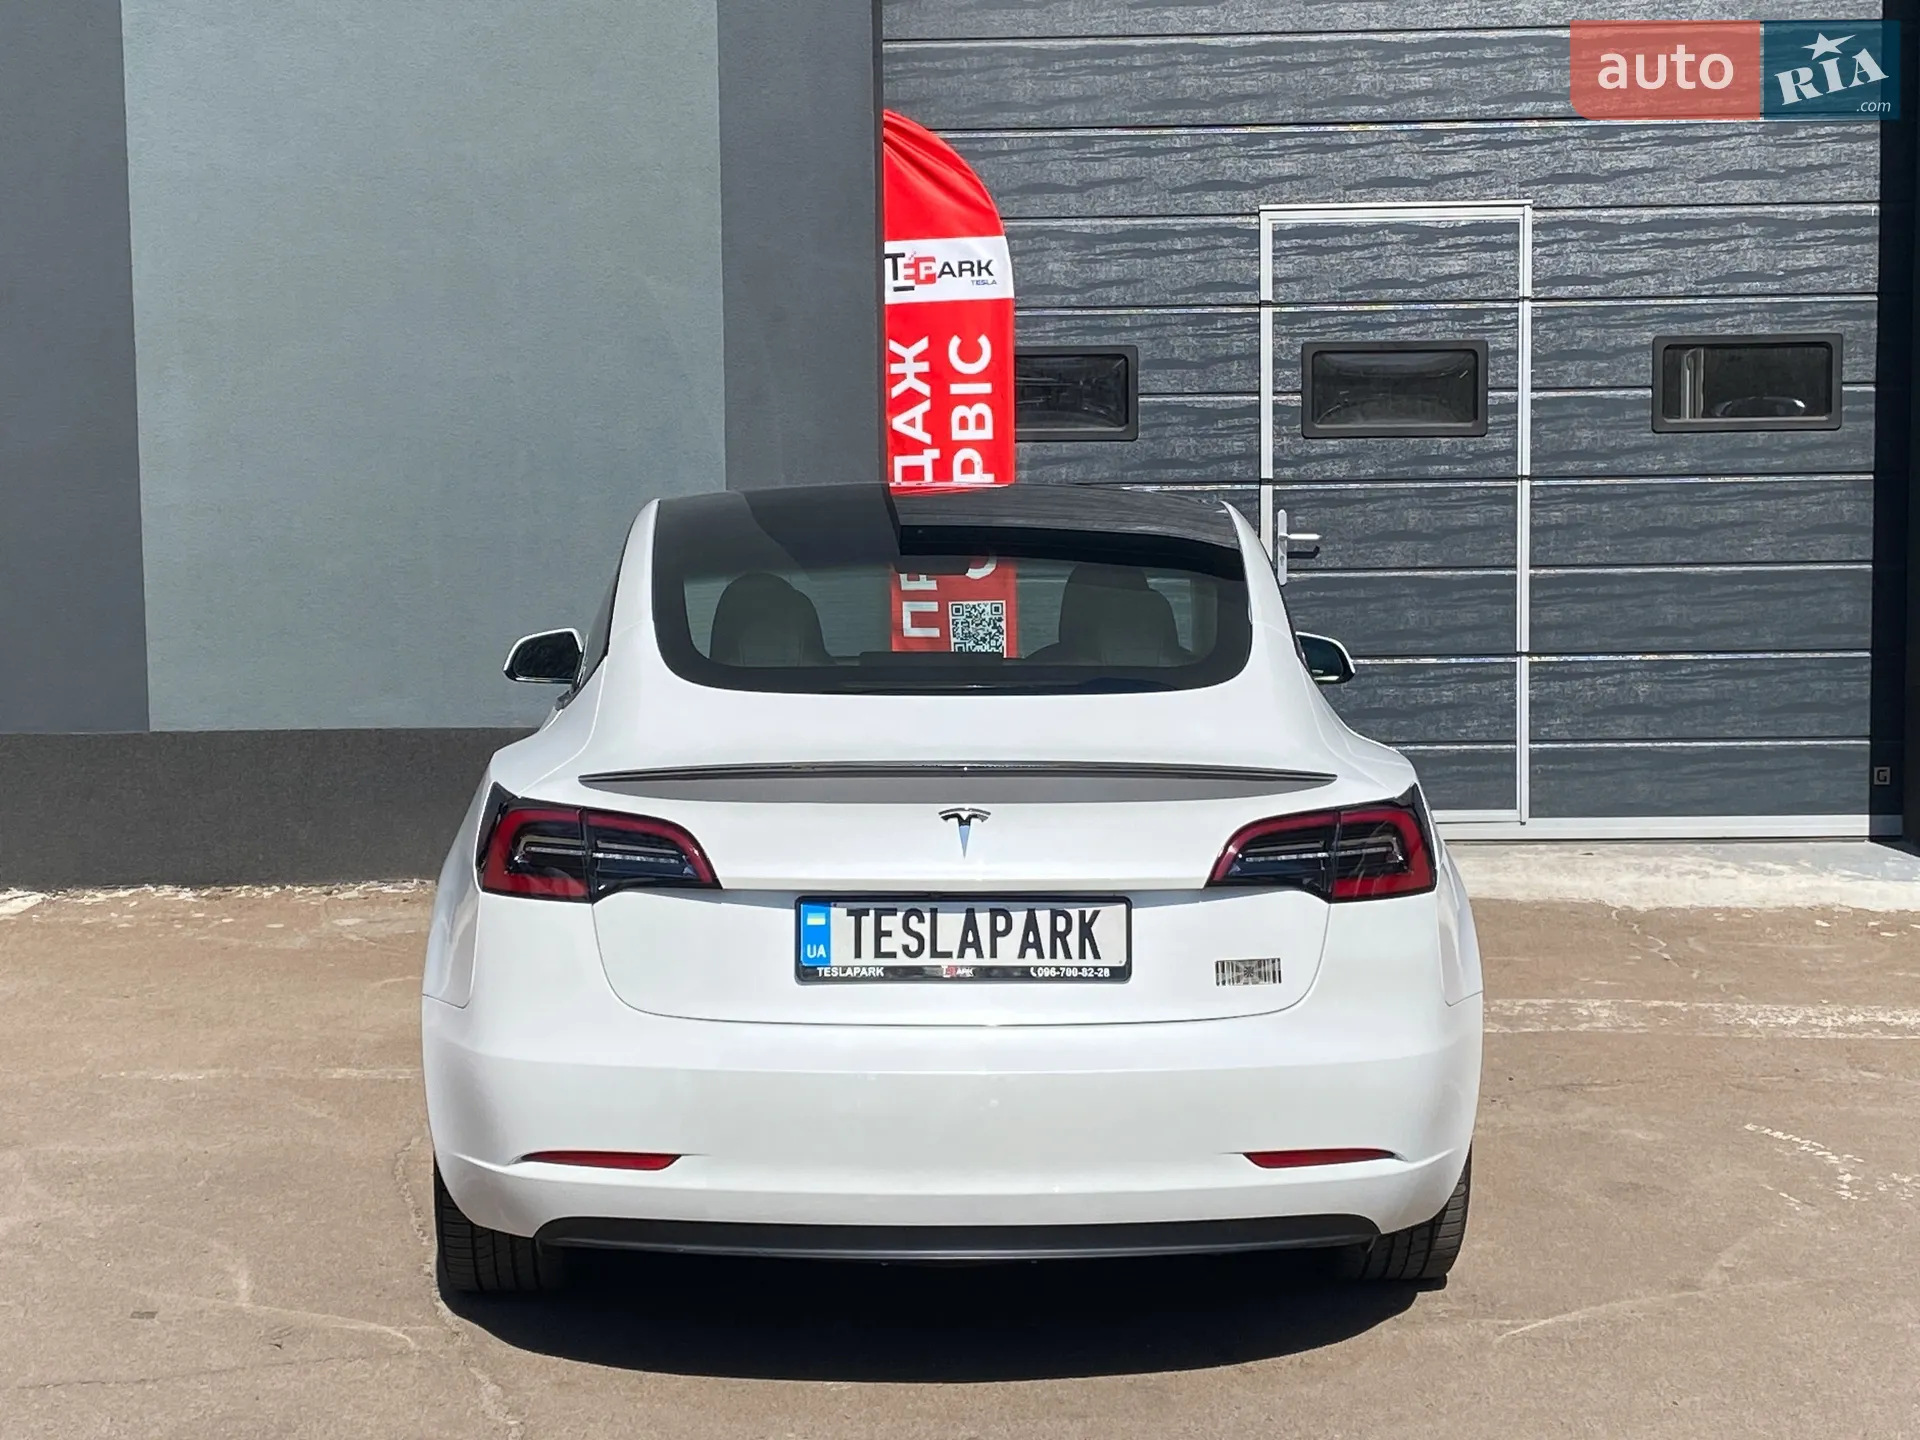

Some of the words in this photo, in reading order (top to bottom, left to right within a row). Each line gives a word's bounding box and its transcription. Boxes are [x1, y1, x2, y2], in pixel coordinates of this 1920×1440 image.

[970, 279, 998, 287] TESLA
[806, 944, 827, 959] UA
[846, 907, 1103, 960] TESLAPARK
[816, 966, 885, 978] TESLAPARK
